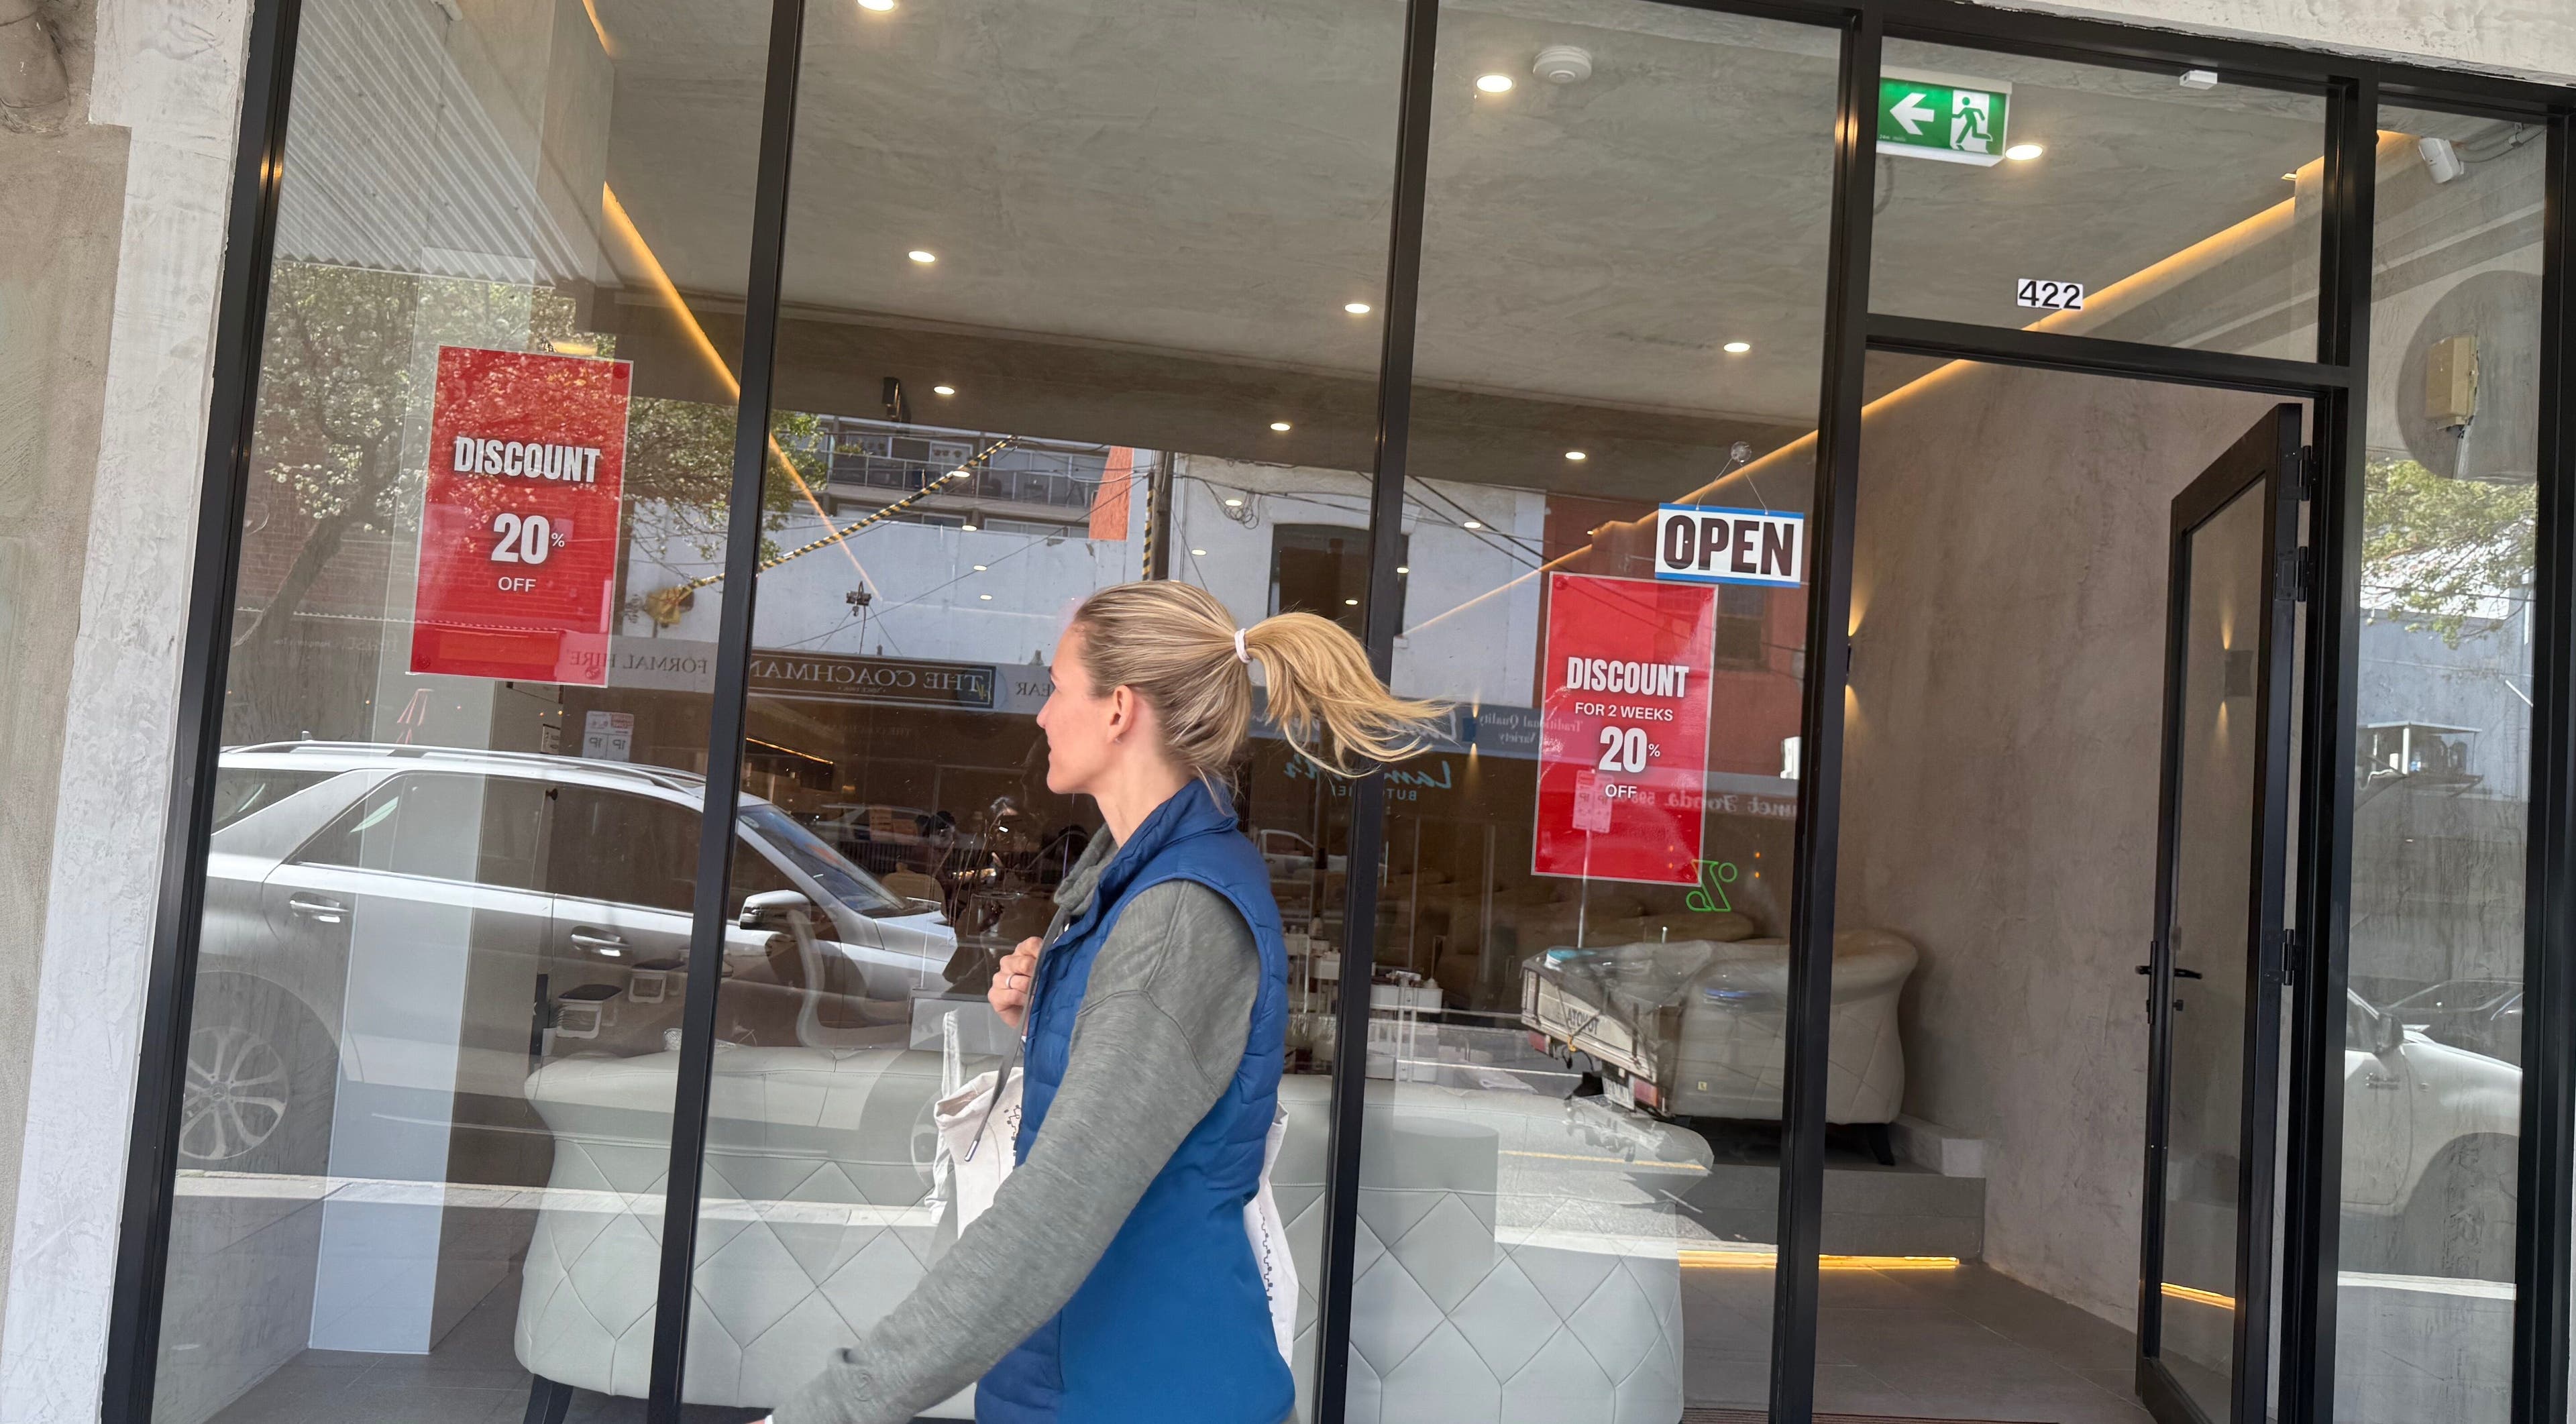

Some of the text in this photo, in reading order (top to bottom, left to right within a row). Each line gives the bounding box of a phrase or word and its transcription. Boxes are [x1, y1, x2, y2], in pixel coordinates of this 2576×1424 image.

[2019, 280, 2081, 310] 422
[453, 435, 601, 483] DISCOUNT
[1663, 514, 1794, 577] OPEN
[498, 576, 537, 592] OFF
[1566, 656, 1689, 698] DISCOUNT
[1574, 702, 1674, 722] FOR 2 WEEKS
[1605, 783, 1638, 798] OFF
